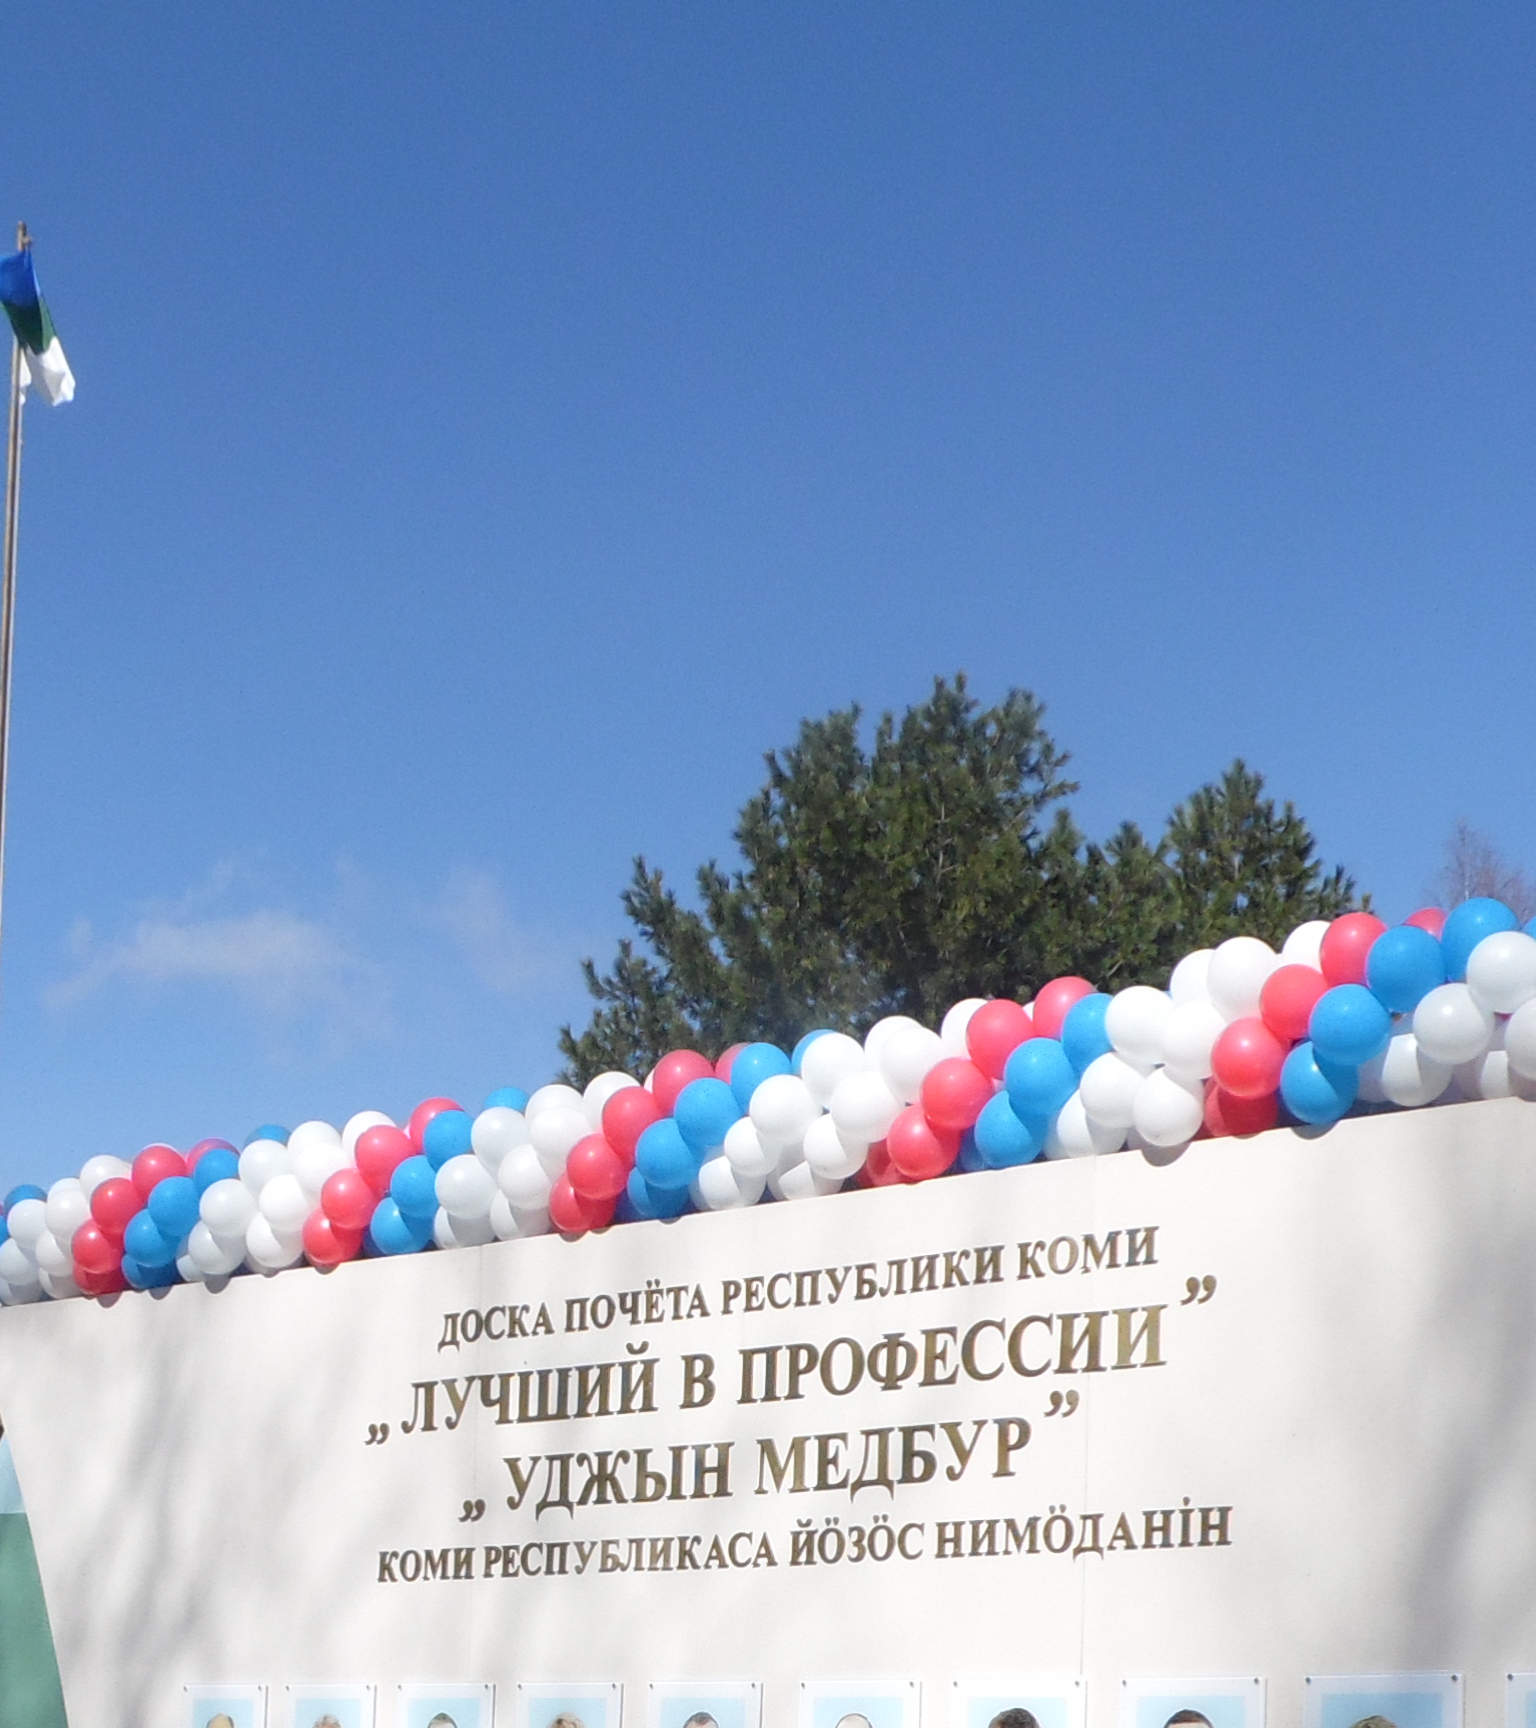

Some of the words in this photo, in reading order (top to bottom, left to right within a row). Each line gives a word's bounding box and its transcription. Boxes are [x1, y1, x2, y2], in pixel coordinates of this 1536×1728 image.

[438, 1302, 555, 1352] ДОСКА
[564, 1279, 711, 1333] ПОЧЁТА
[721, 1244, 1006, 1315] РЕСПУБЛИКИ
[1017, 1226, 1160, 1280] КОМИ
[679, 1353, 716, 1409] В
[377, 1547, 475, 1583] КОМИ
[483, 1531, 778, 1578] РЕСПУБЛИКАСА
